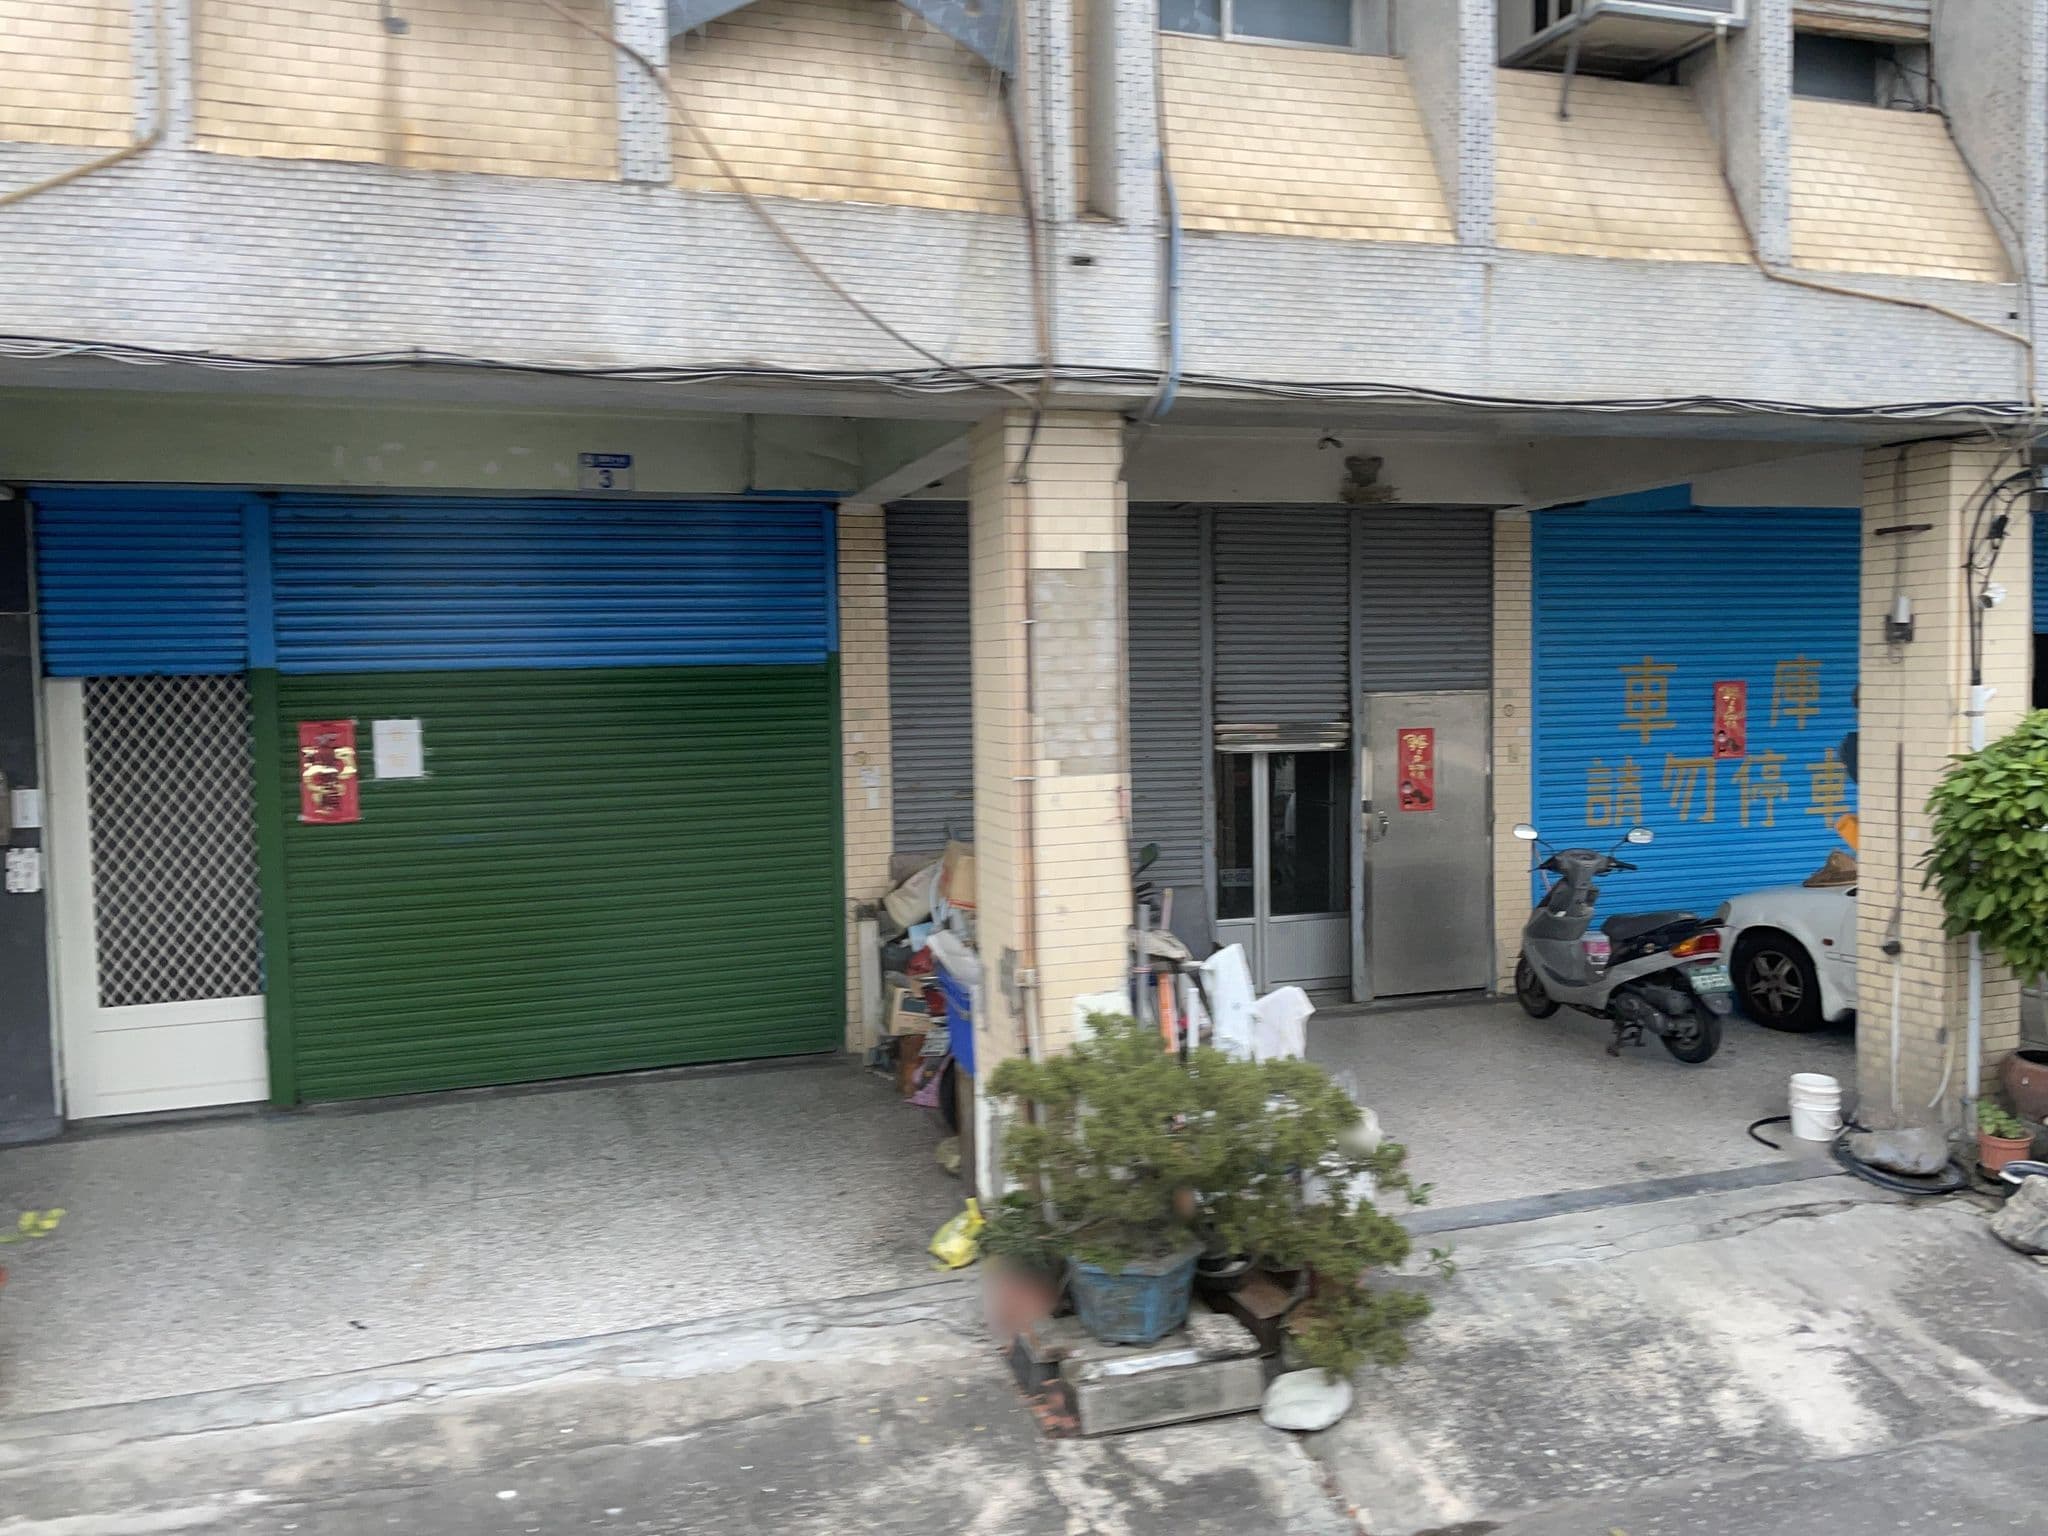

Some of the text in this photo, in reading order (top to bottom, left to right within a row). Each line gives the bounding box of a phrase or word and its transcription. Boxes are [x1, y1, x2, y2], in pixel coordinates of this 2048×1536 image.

[599, 470, 612, 488] 3
[1617, 655, 1823, 744] 車庫
[1585, 747, 1850, 831] 請勿停車
